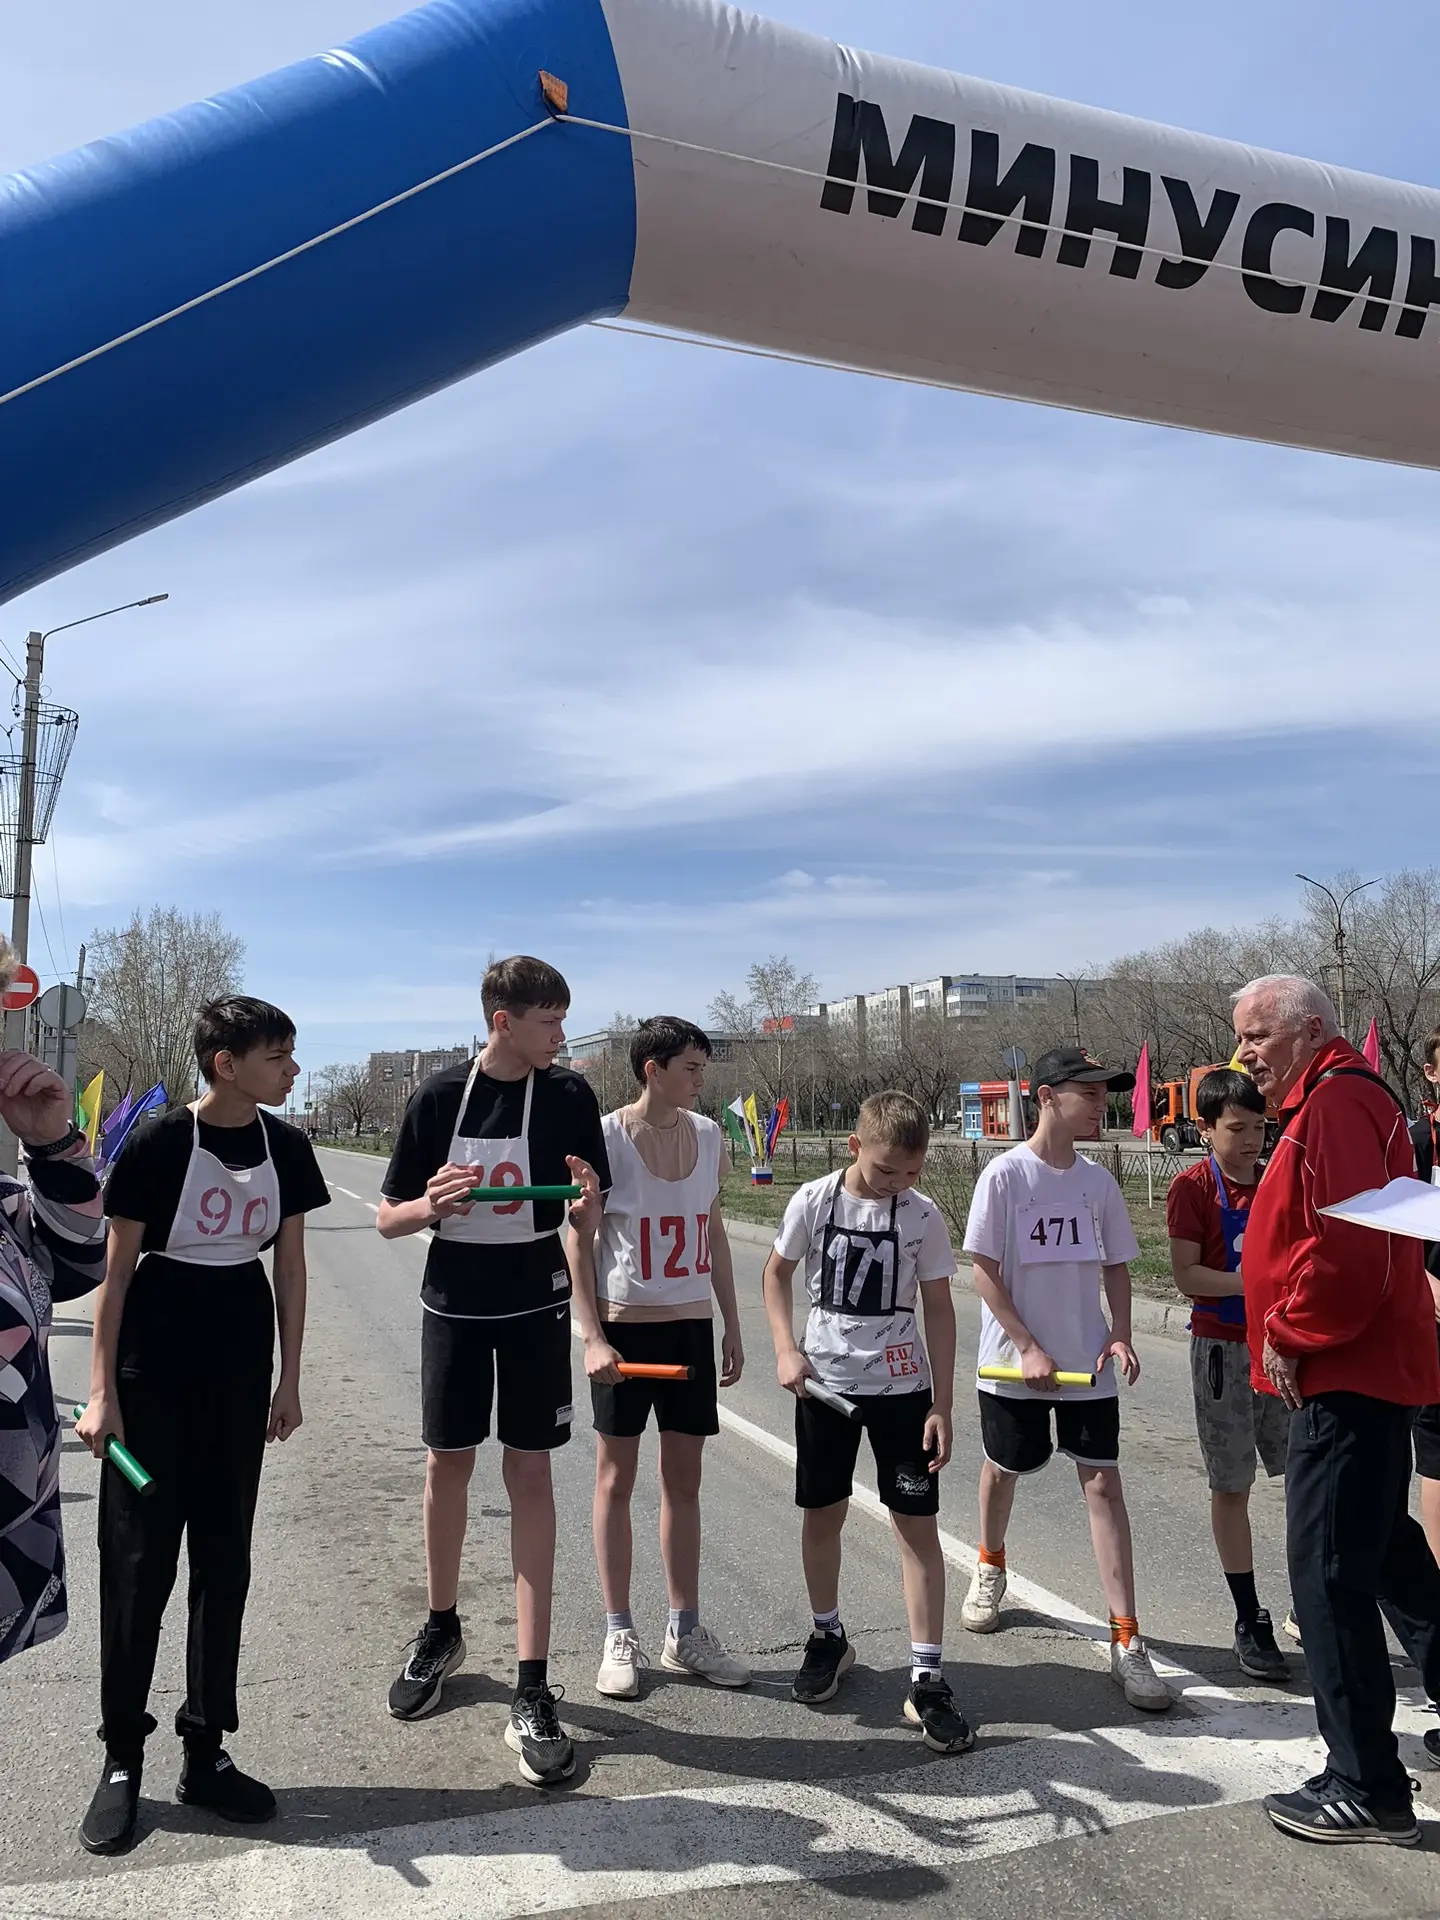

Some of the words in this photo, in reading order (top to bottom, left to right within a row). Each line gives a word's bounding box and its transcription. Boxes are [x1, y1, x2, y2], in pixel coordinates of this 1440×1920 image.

[196, 1186, 268, 1236] 90
[1030, 1216, 1083, 1246] 471
[640, 1213, 711, 1280] 120
[827, 1233, 894, 1311] 171
